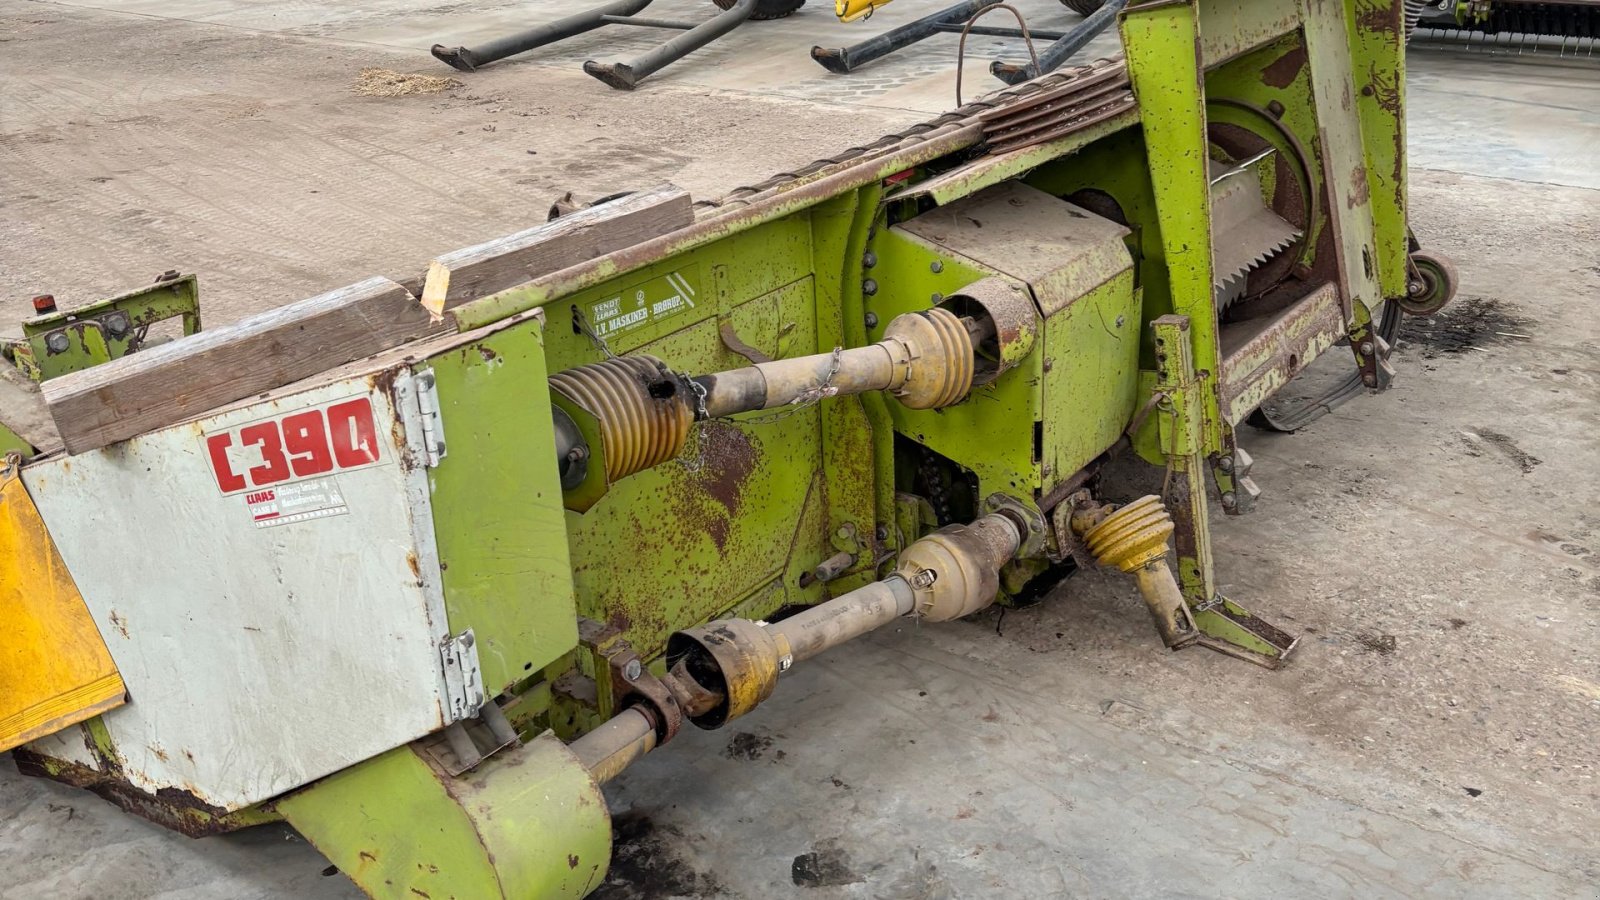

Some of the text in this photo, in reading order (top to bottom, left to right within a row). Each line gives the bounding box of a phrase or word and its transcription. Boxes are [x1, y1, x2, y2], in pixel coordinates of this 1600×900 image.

[594, 299, 620, 312] FENDT
[596, 308, 618, 321] CLAAS
[608, 307, 648, 331] MASKINER
[207, 397, 380, 492] C390
[246, 490, 275, 504] CLAAS
